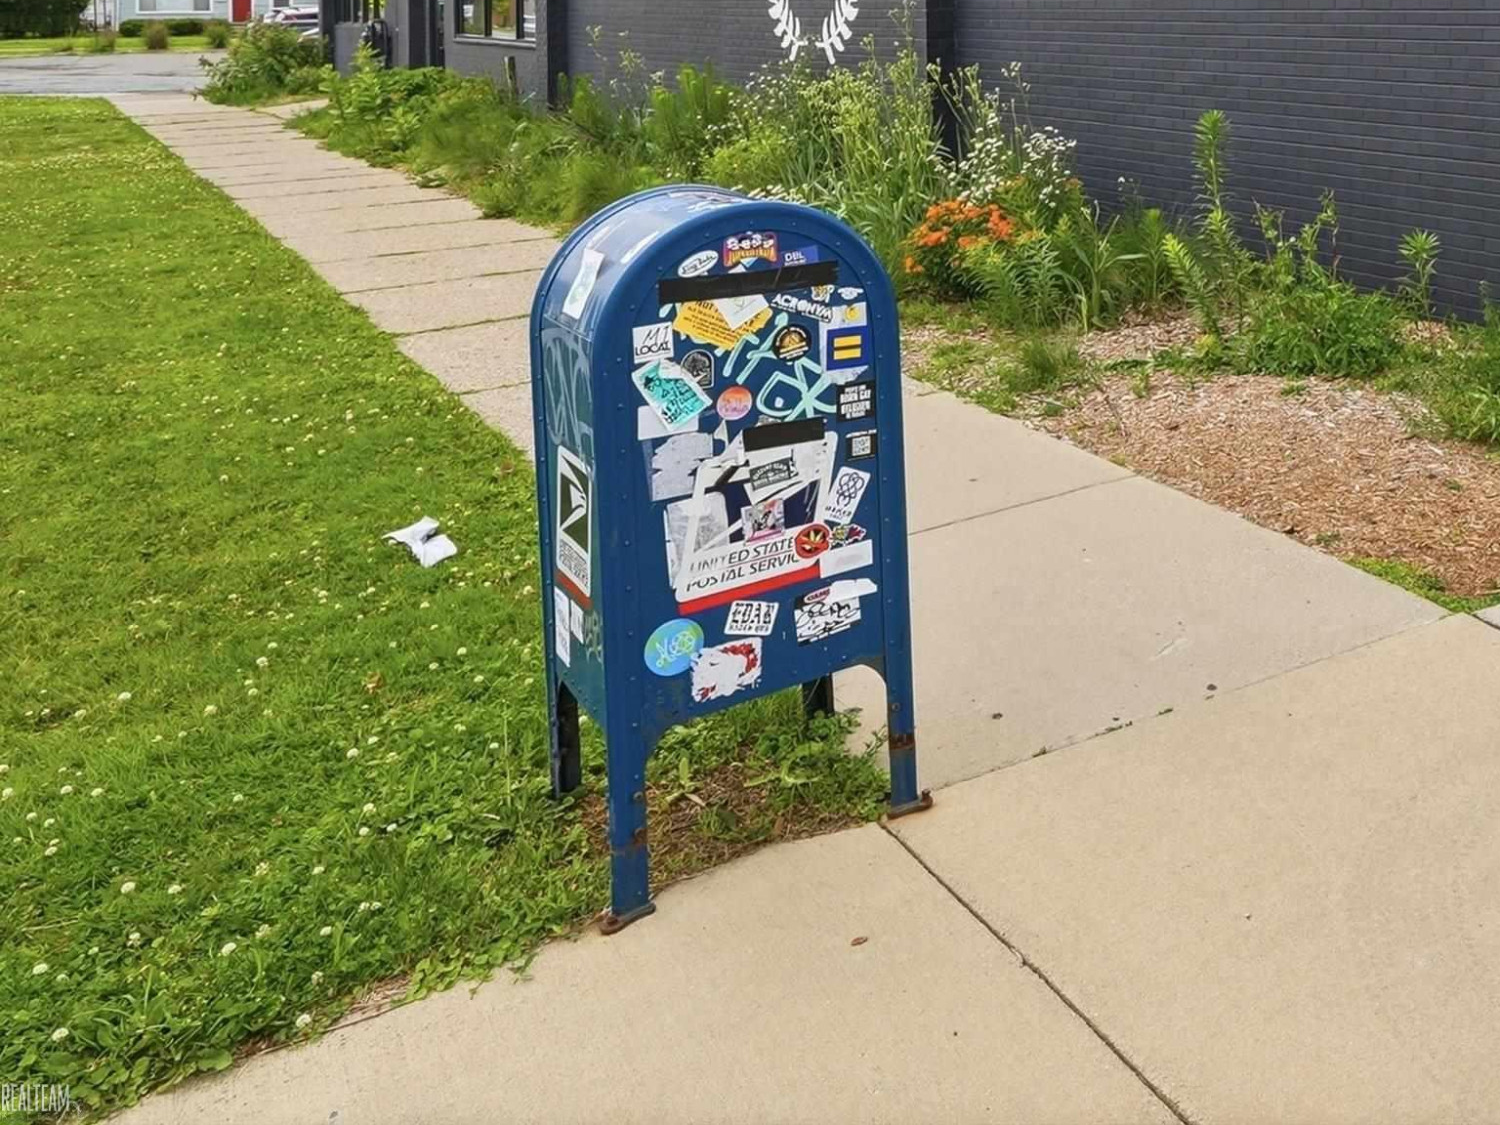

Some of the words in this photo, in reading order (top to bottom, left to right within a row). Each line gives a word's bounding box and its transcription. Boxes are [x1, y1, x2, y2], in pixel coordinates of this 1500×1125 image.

[772, 293, 833, 321] ACRONYM
[751, 537, 794, 557] STATE
[750, 553, 799, 575] SERVIC
